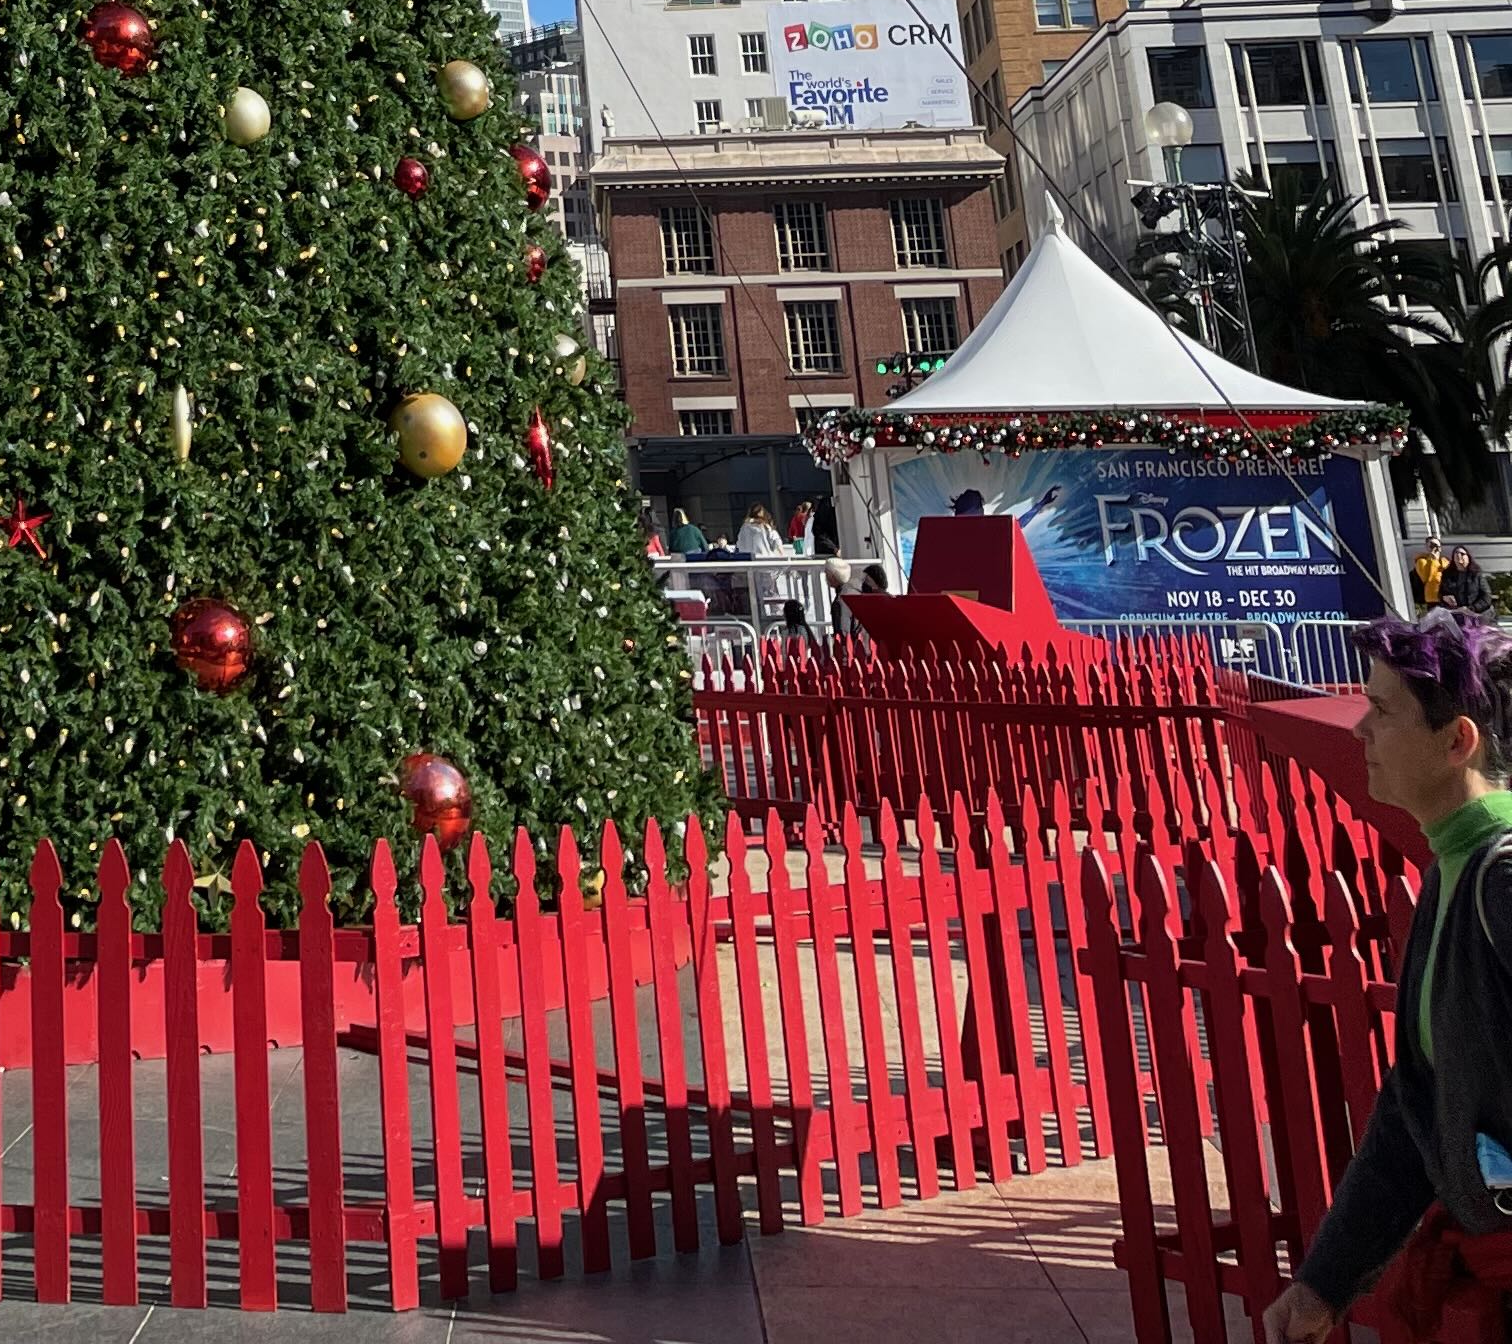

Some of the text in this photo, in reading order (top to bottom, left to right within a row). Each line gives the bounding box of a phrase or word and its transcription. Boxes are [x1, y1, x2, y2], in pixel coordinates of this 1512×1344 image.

[787, 23, 953, 51] ZOHO CRM
[789, 70, 812, 81] The
[806, 77, 852, 89] world's
[789, 77, 888, 105] Favorite
[1096, 459, 1325, 479] SAN FRANCISCO PREMIERE!
[1096, 486, 1342, 576] FROZEN
[1226, 564, 1347, 576] THE HIT BROADWAY MUSICAL
[1167, 590, 1199, 608] NOV
[1204, 590, 1222, 607] 18
[1239, 589, 1271, 607] DEC
[1274, 589, 1296, 607] 30
